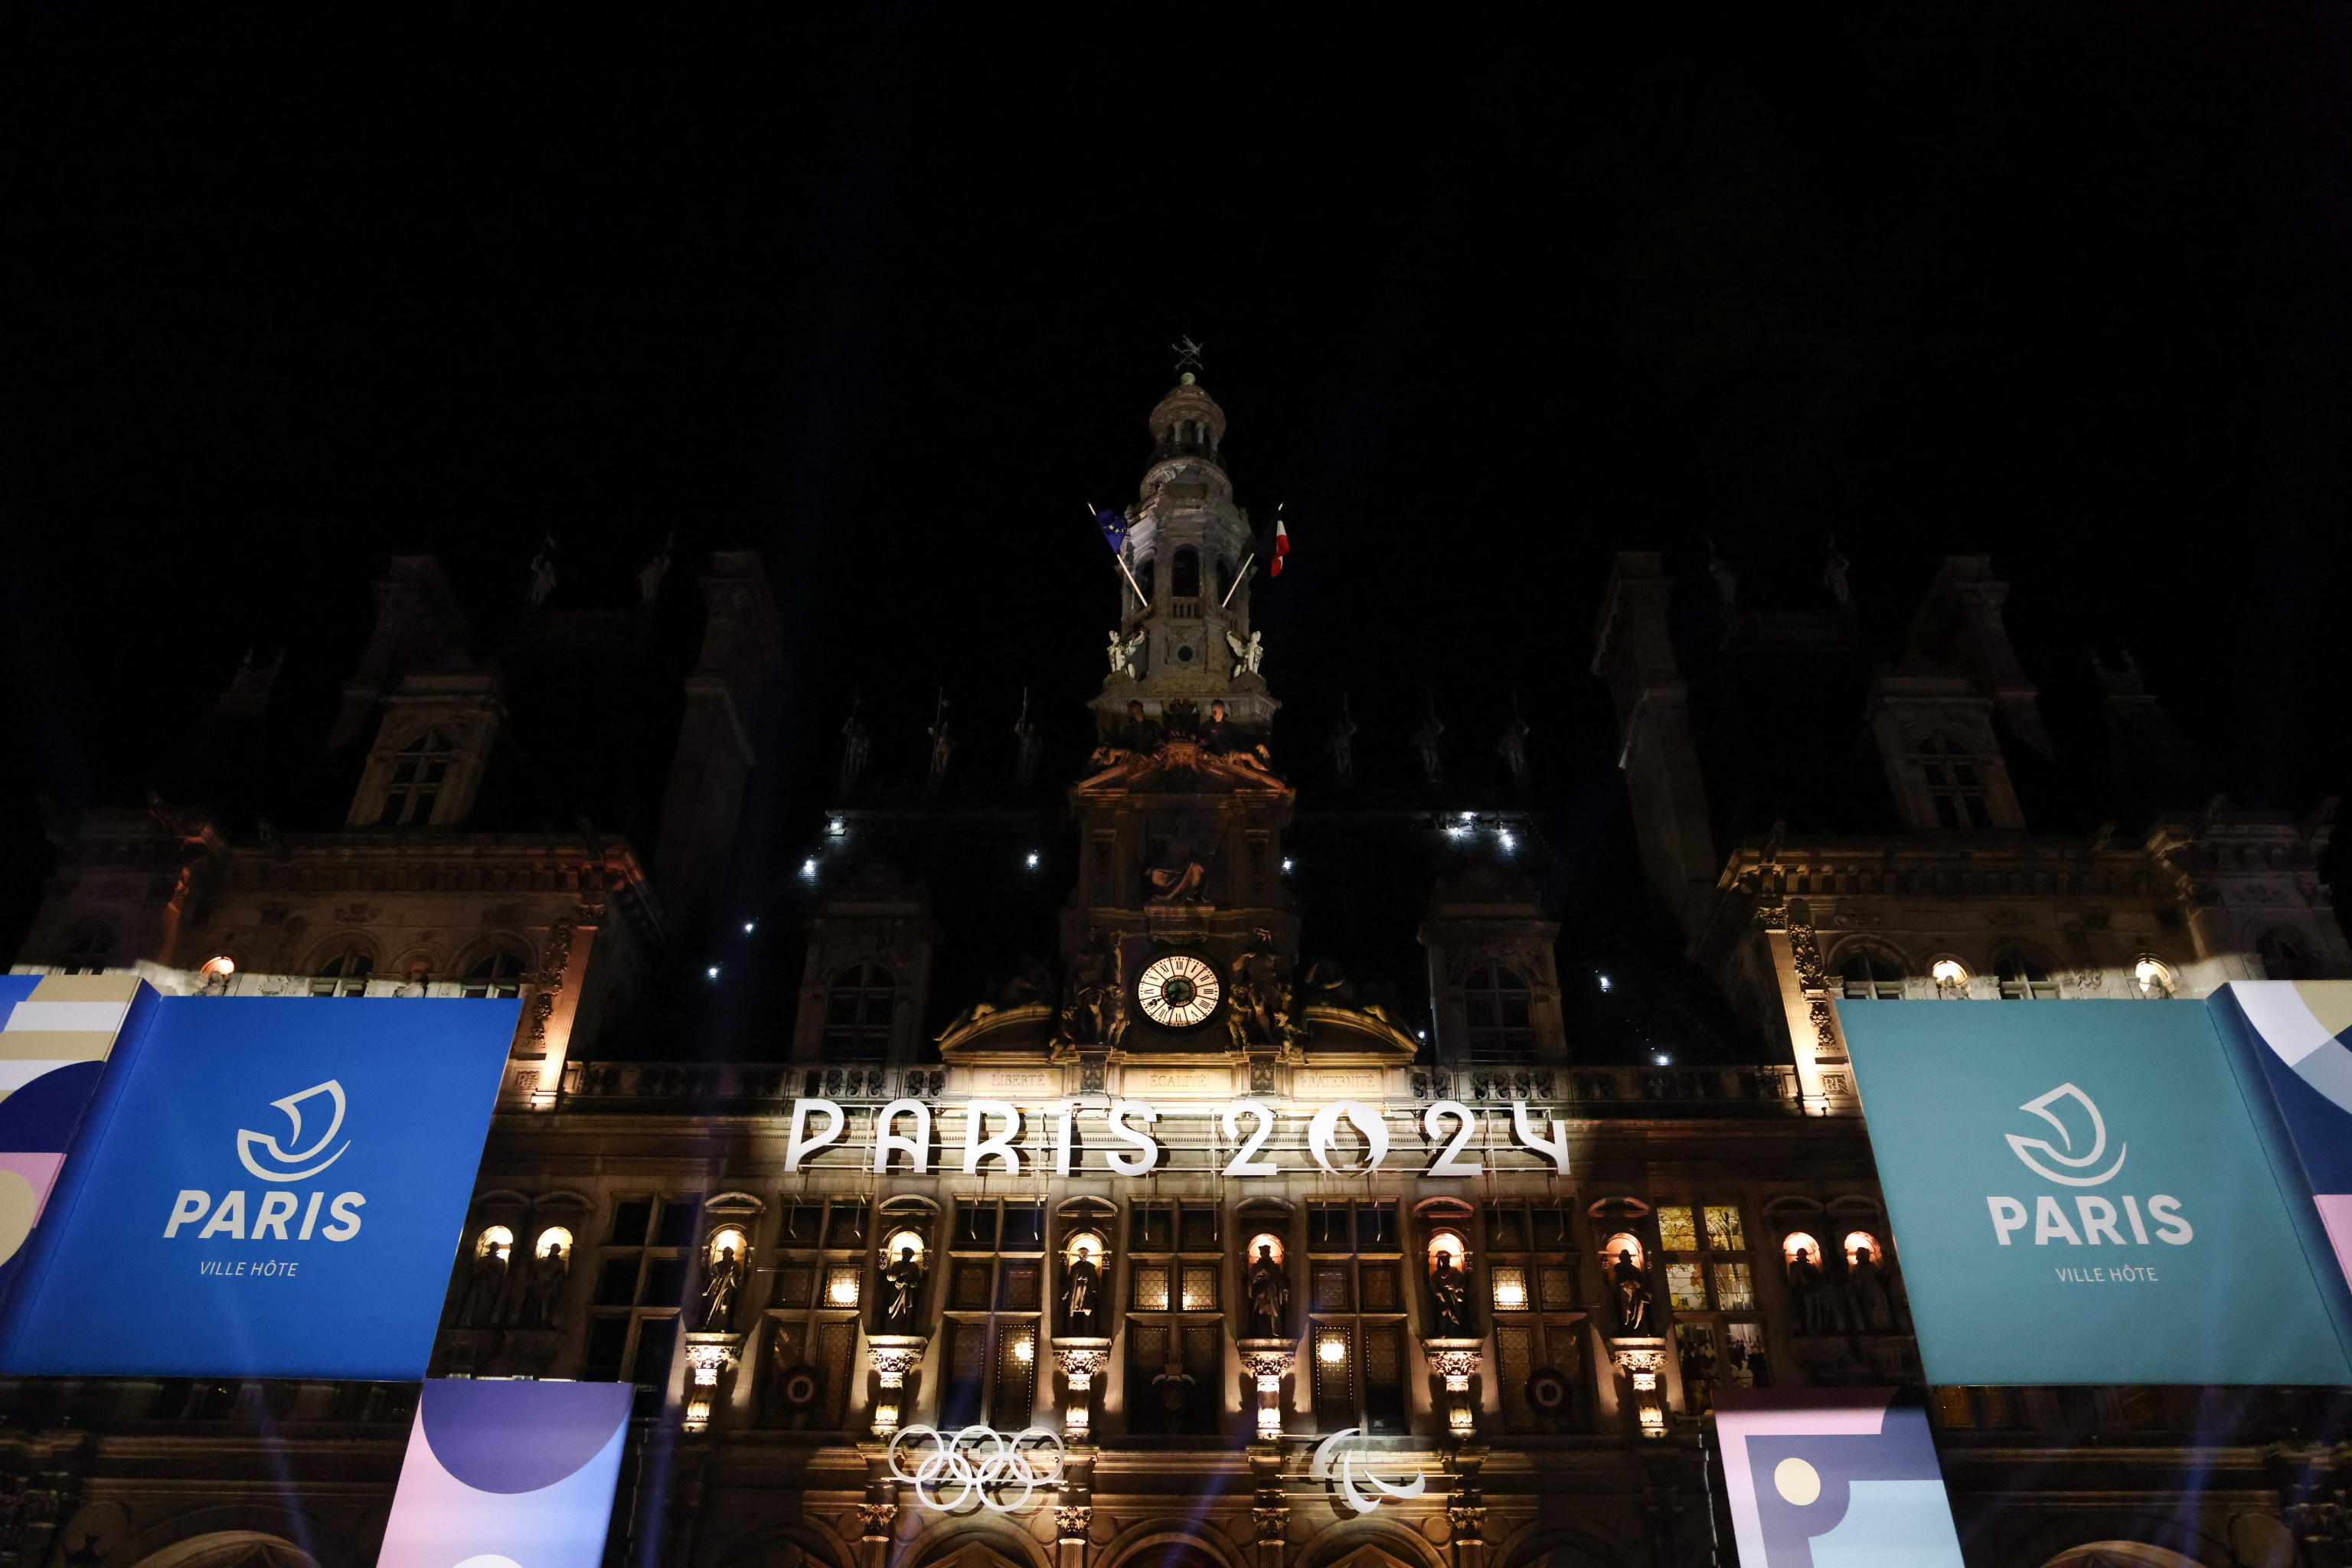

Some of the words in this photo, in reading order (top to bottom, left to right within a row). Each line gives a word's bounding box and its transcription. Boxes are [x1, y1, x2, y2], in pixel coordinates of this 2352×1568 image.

[1191, 965, 1197, 973] I
[991, 1073, 1045, 1086] LIBERTÉ
[1149, 1073, 1207, 1087] ÉGALITÉ
[1300, 1074, 1375, 1087] FRATERNITÉ
[784, 1098, 1158, 1176] PARIS
[1221, 1100, 1570, 1177] 2024
[163, 1190, 367, 1241] PARIS
[1987, 1194, 2194, 1245] PARIS
[201, 1262, 246, 1276] VILLE
[250, 1259, 299, 1276] HÔTE
[2056, 1268, 2105, 1282] VILLE
[2109, 1265, 2158, 1282] HÔTE
